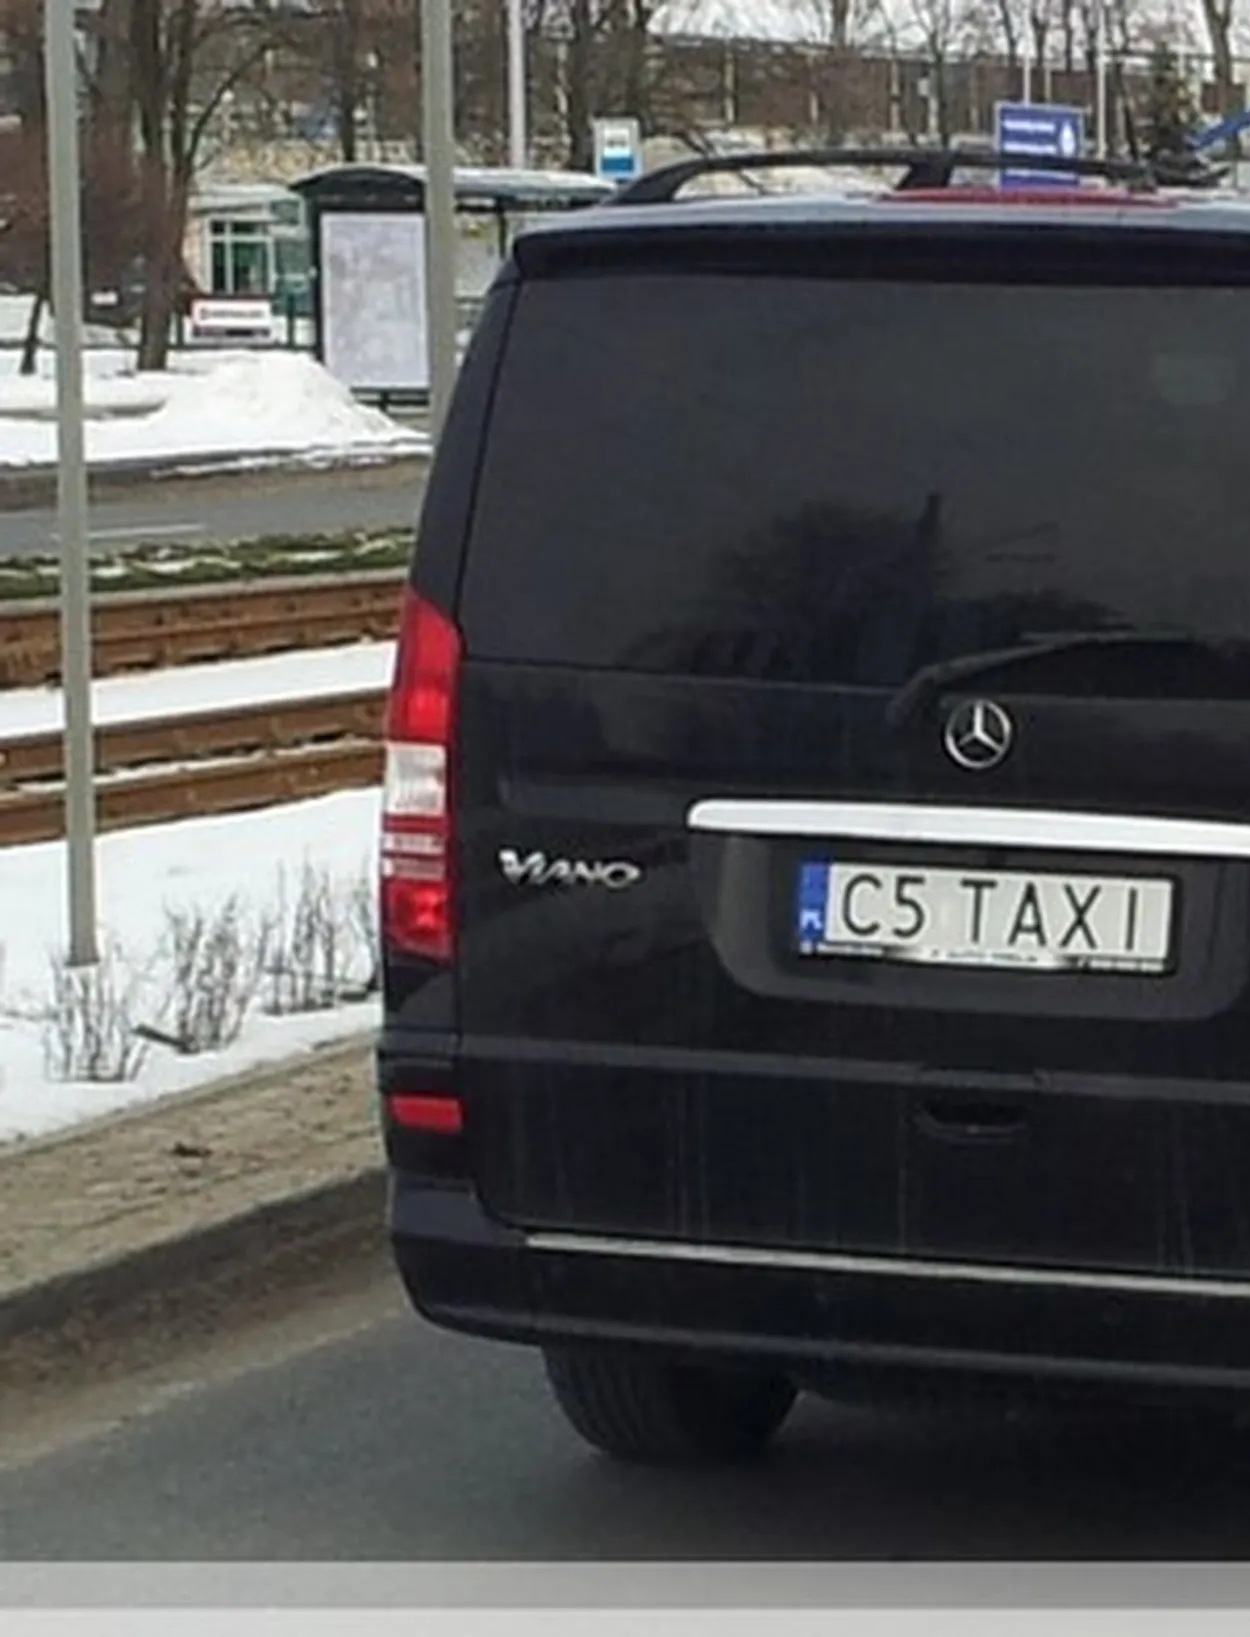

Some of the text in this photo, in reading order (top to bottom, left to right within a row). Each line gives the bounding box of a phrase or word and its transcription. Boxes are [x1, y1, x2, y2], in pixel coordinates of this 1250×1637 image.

[499, 849, 642, 889] VIANO
[841, 873, 1138, 951] C5 TAXI
